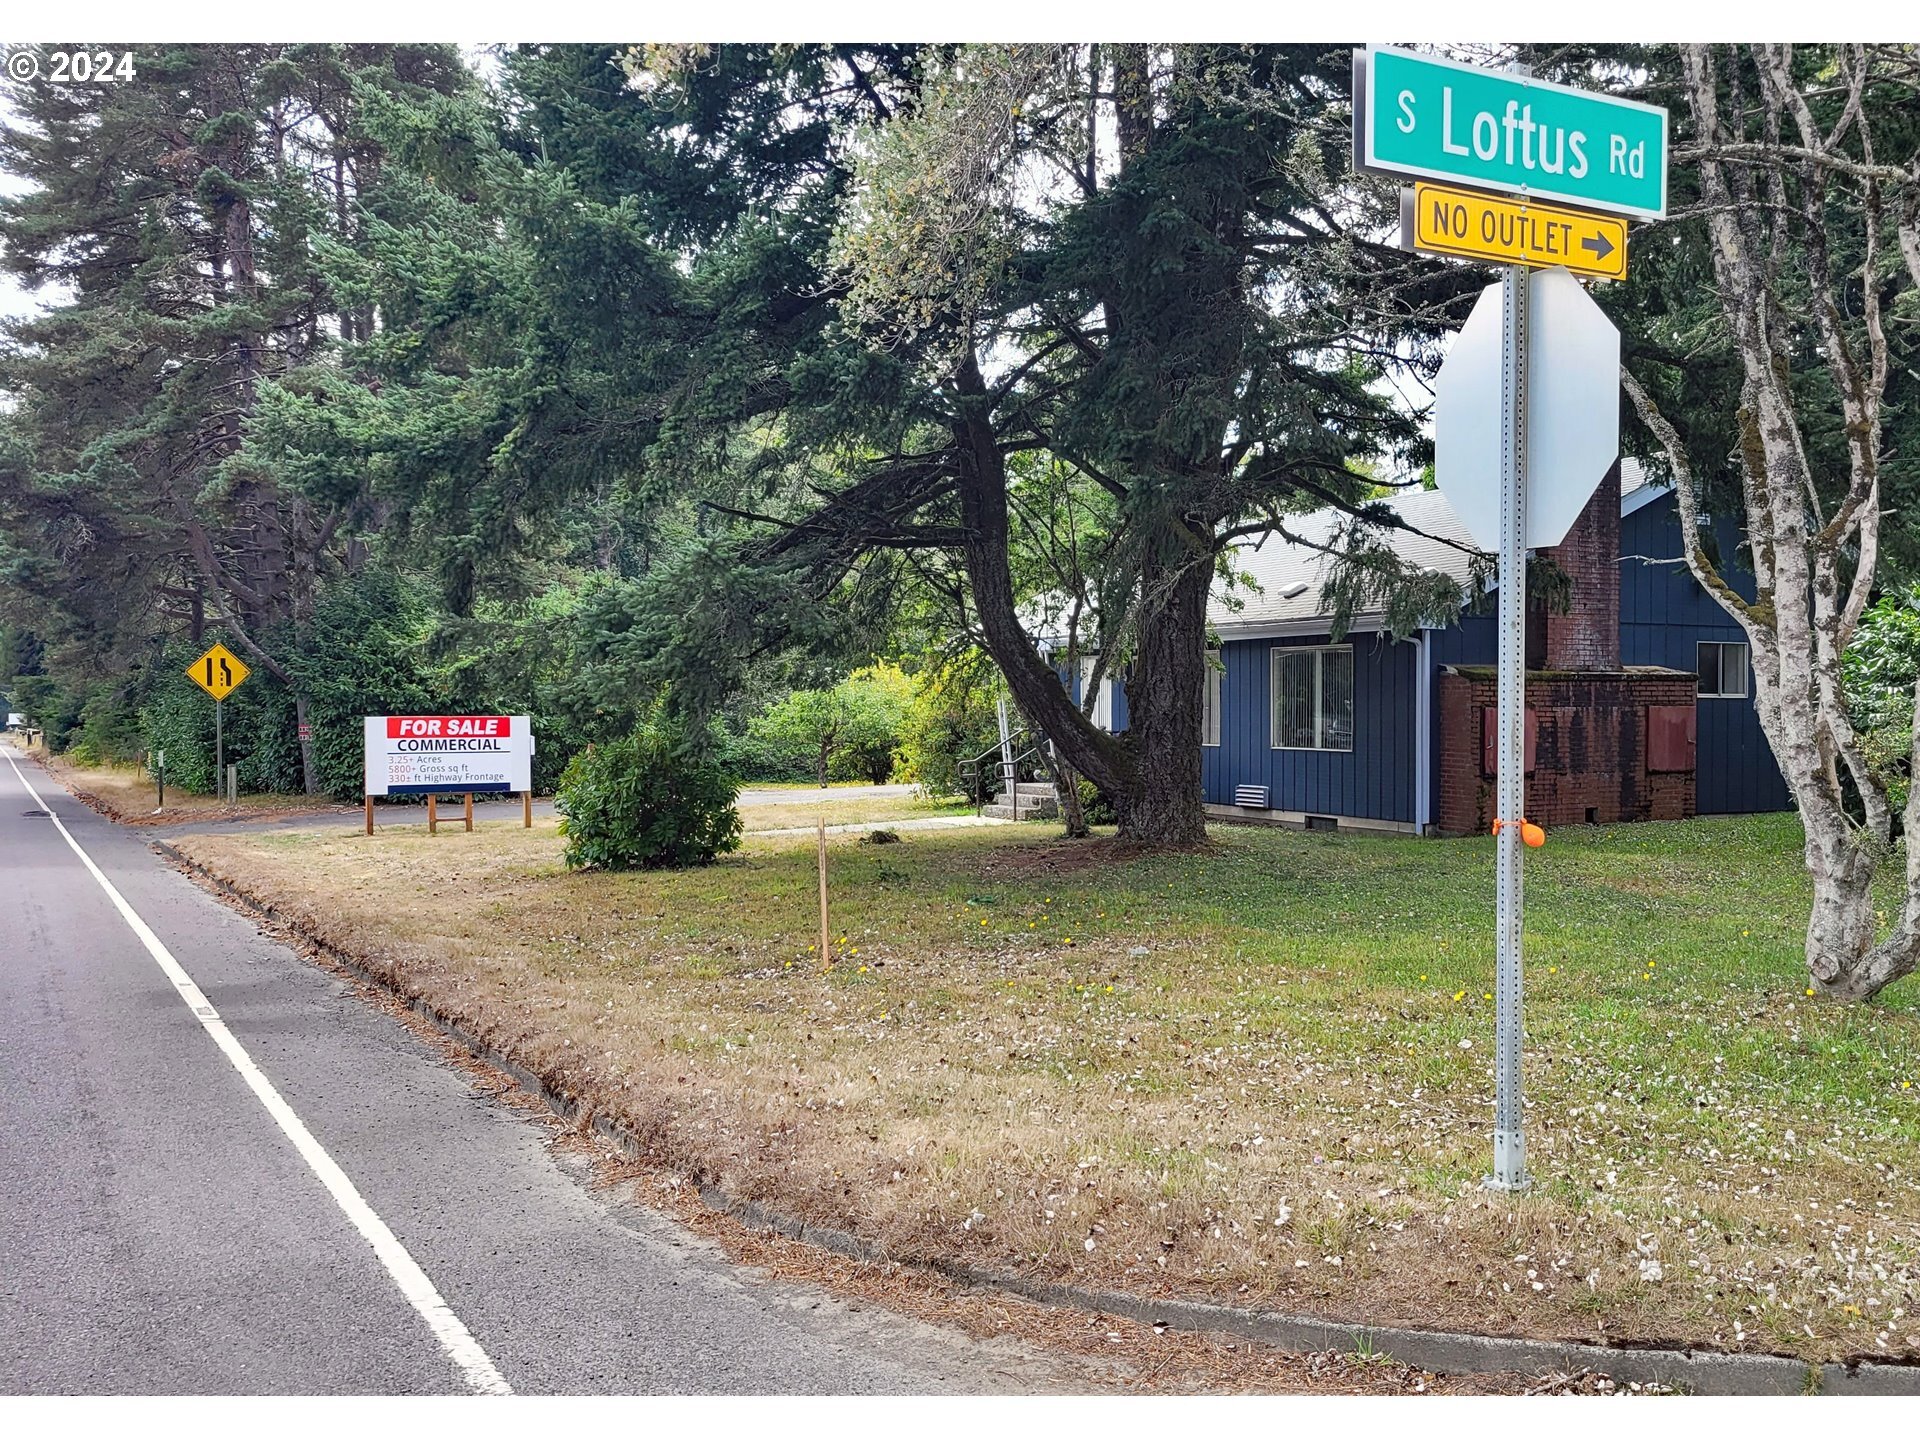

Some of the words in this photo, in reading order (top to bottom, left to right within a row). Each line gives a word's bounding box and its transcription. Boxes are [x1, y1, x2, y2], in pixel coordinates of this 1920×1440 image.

[1396, 90, 1416, 133] S
[1443, 86, 1588, 178] Loftus
[1609, 134, 1644, 179] Rd
[1433, 201, 1468, 239] NO
[1481, 210, 1572, 256] OUTLET
[400, 720, 441, 736] FOR
[447, 719, 498, 735] SALE
[397, 739, 501, 751] COMMERCIAL
[417, 755, 442, 763] Acres
[420, 764, 446, 773] Gross
[448, 765, 459, 773] sq
[461, 764, 468, 772] ft
[414, 774, 421, 782] ft
[424, 774, 462, 783] Highway
[465, 772, 504, 781] Frontage
